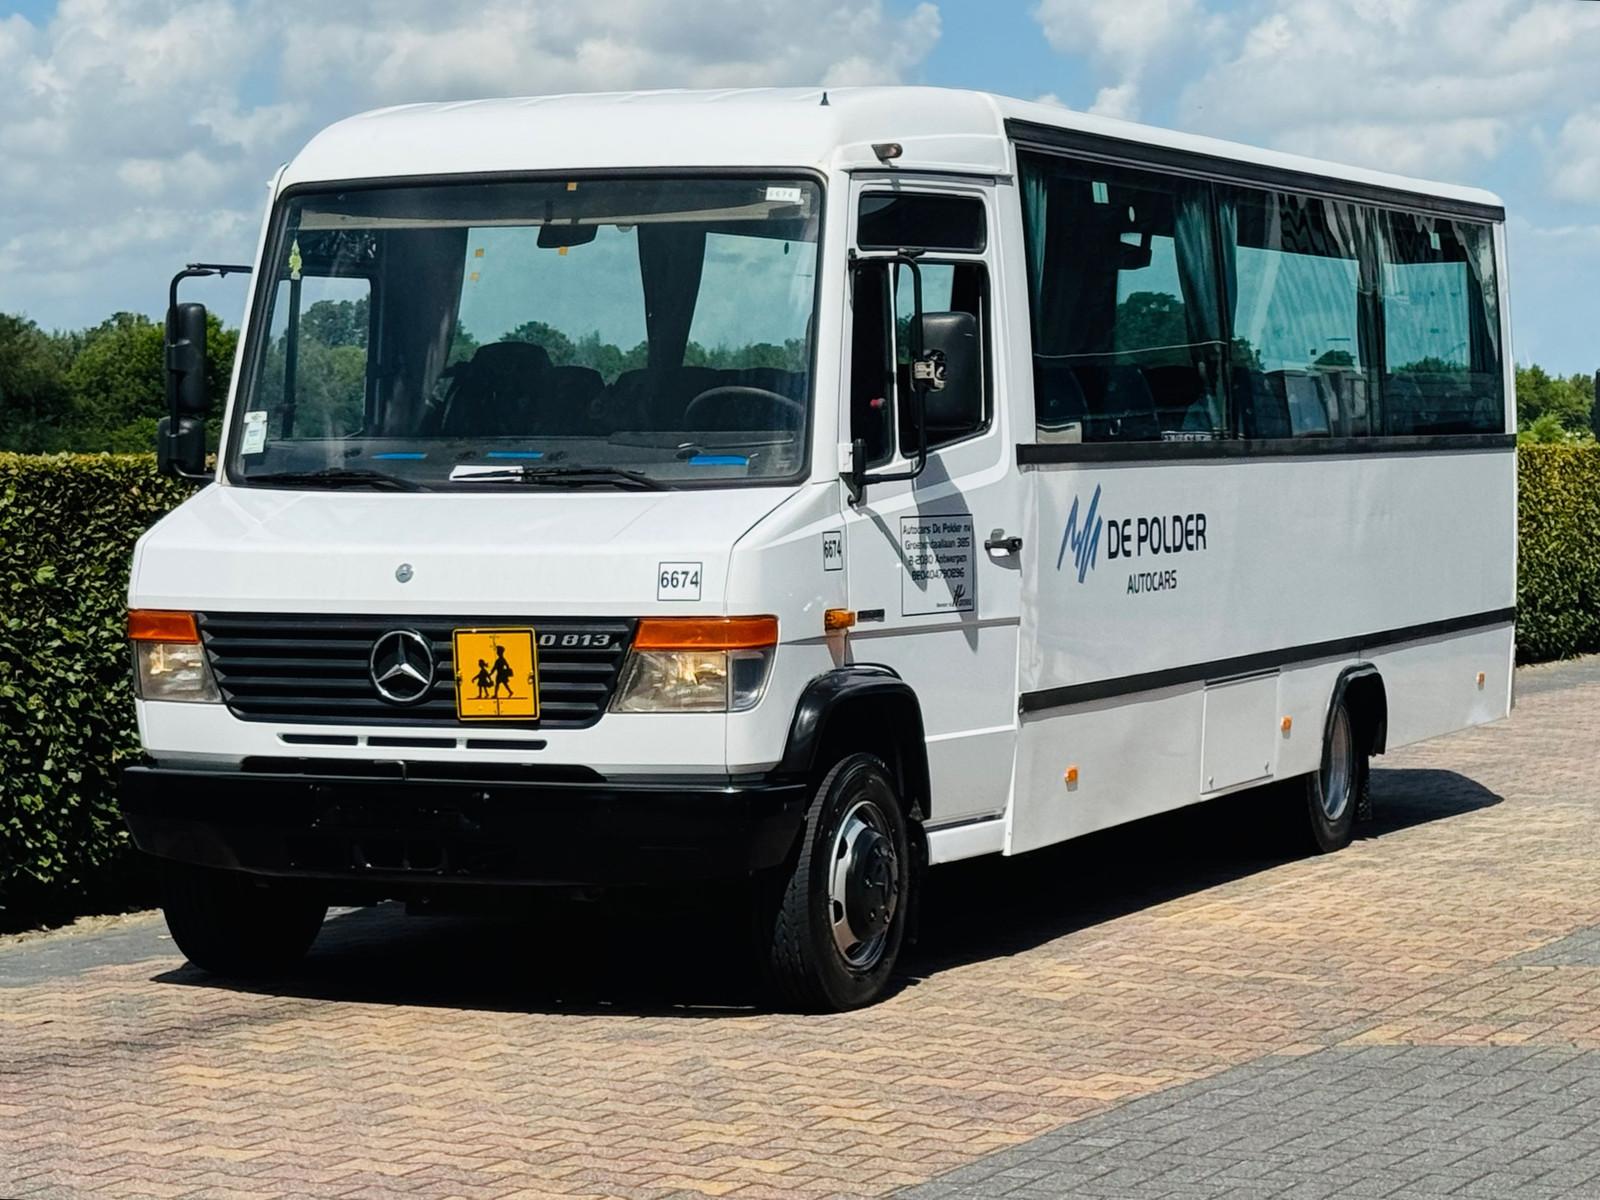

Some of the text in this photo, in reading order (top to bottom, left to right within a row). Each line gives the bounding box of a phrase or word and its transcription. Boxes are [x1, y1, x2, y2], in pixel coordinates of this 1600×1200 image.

[942, 522, 962, 534] Polder
[1107, 513, 1207, 560] DE POLDER
[823, 539, 842, 560] 6674
[660, 570, 700, 589] 6674
[1126, 569, 1177, 595] AUTOCARS
[561, 633, 611, 646] 813
